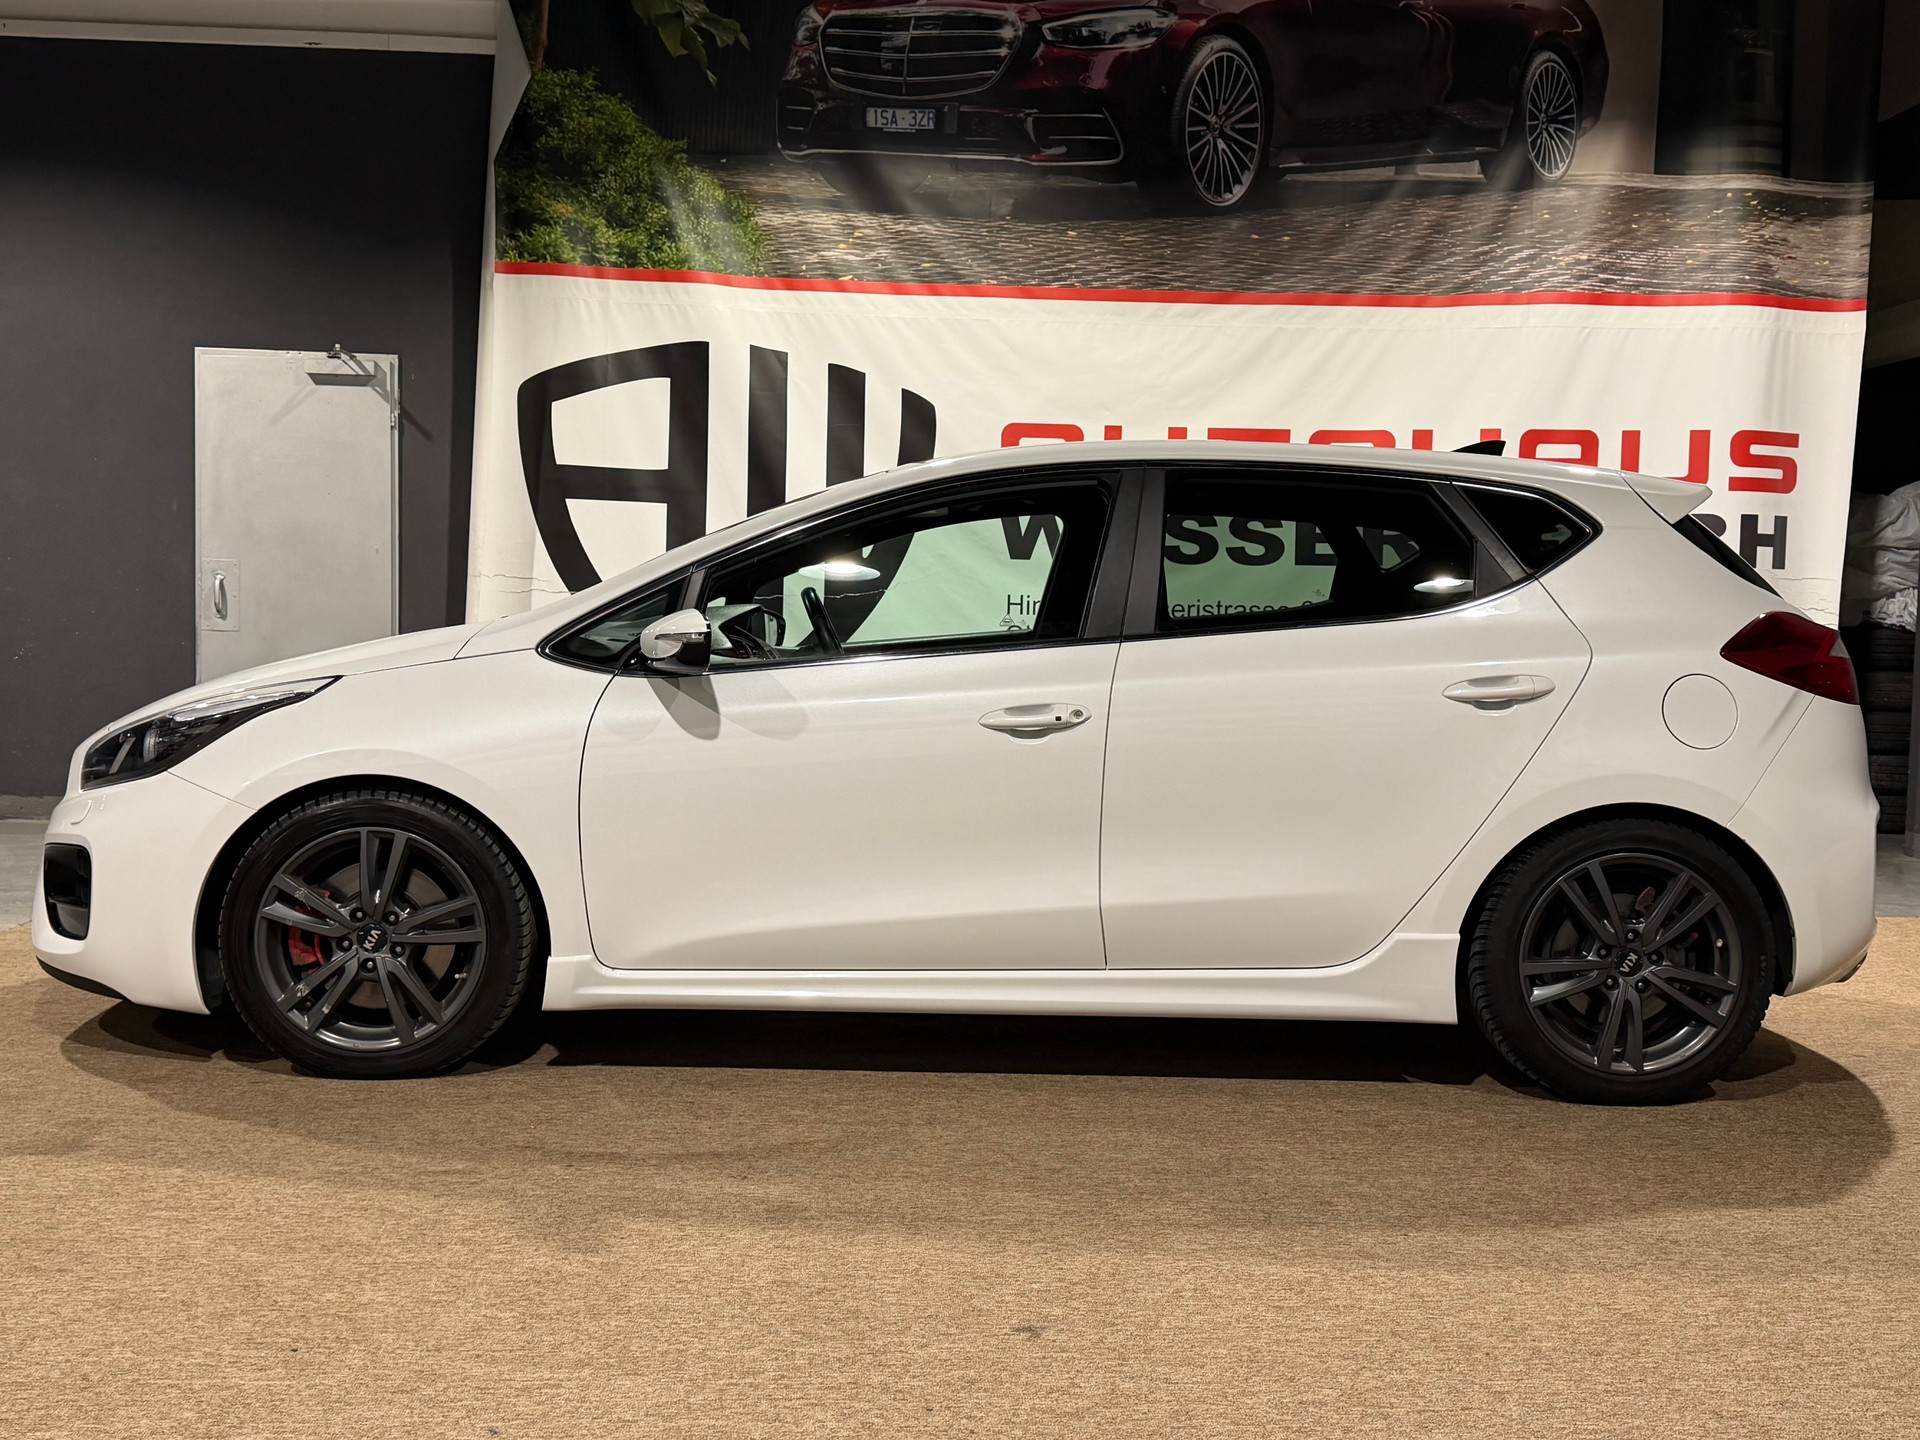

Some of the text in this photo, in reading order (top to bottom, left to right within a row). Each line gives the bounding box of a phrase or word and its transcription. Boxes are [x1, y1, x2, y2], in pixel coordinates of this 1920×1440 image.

[1000, 514, 1421, 567] WSSER
[362, 929, 382, 950] KIA
[1619, 952, 1639, 973] KIA
